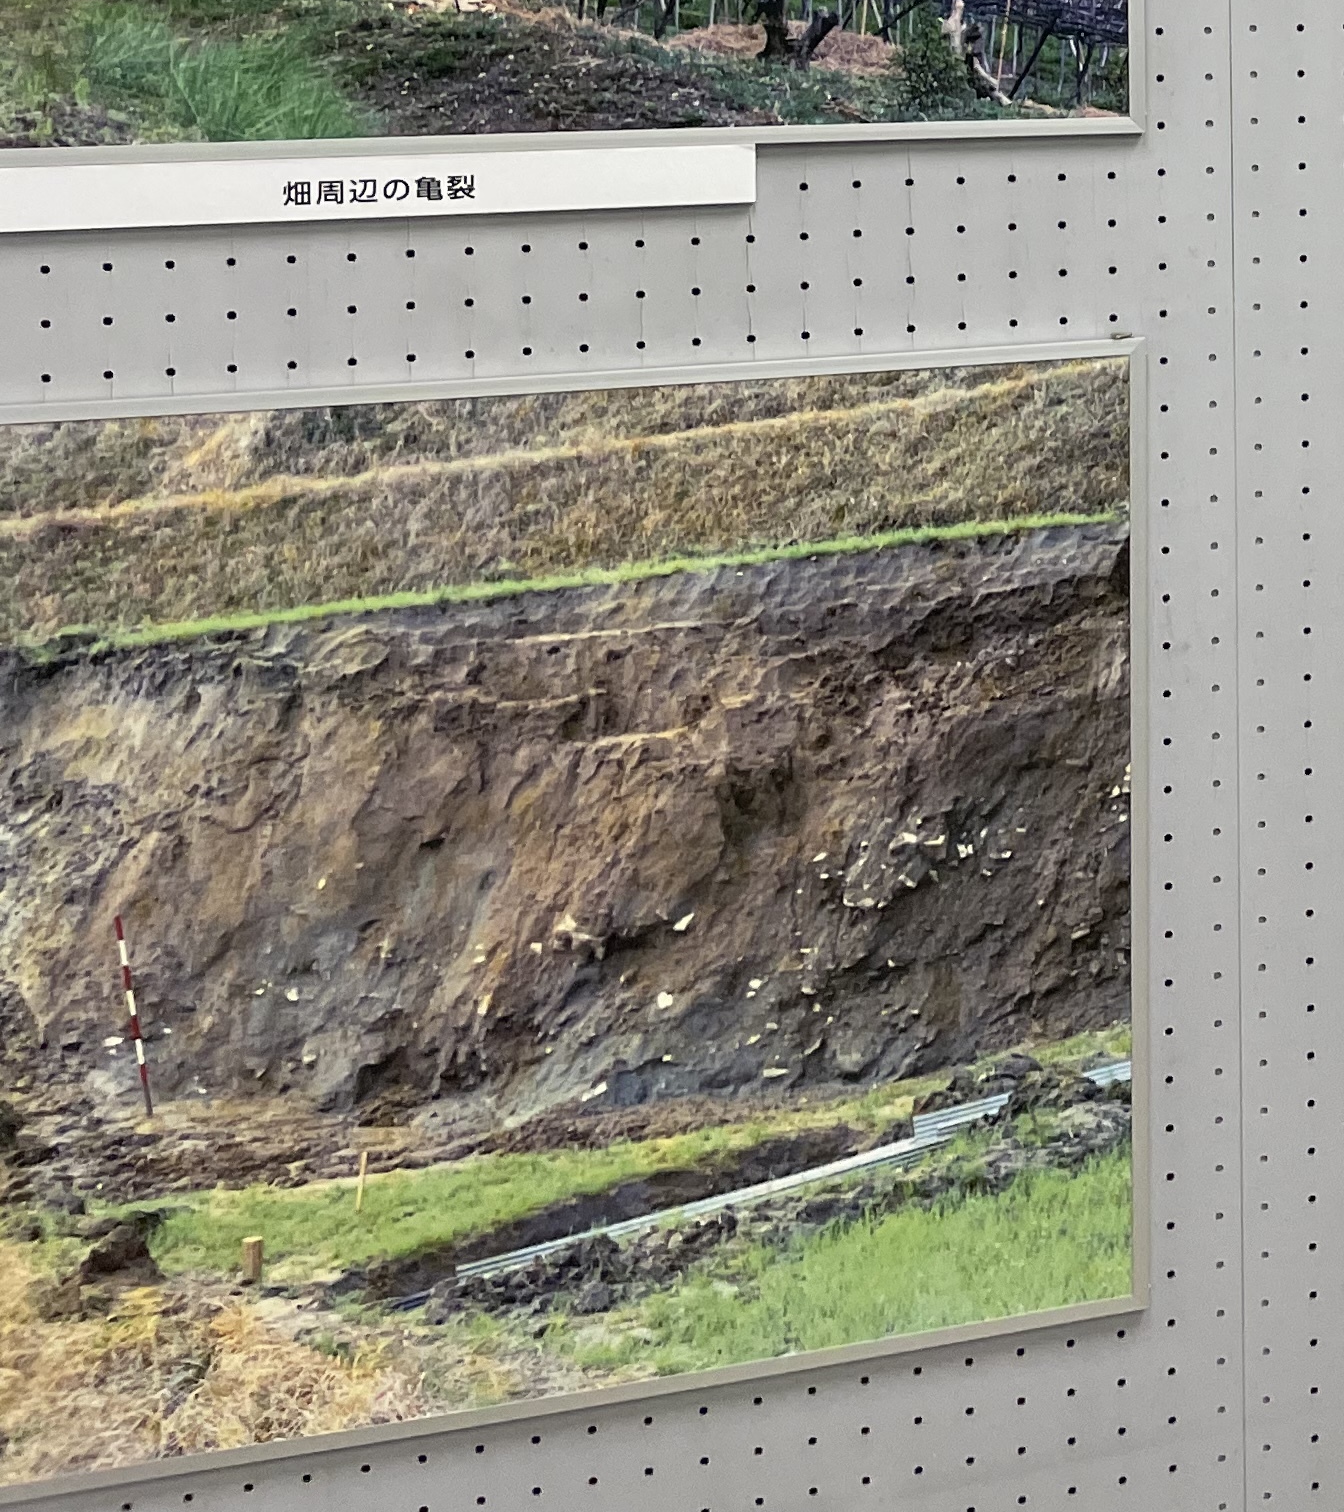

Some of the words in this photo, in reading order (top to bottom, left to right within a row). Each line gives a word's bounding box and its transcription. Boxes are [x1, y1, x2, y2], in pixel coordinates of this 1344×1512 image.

[283, 174, 476, 207] 畑周辺の亀裂
